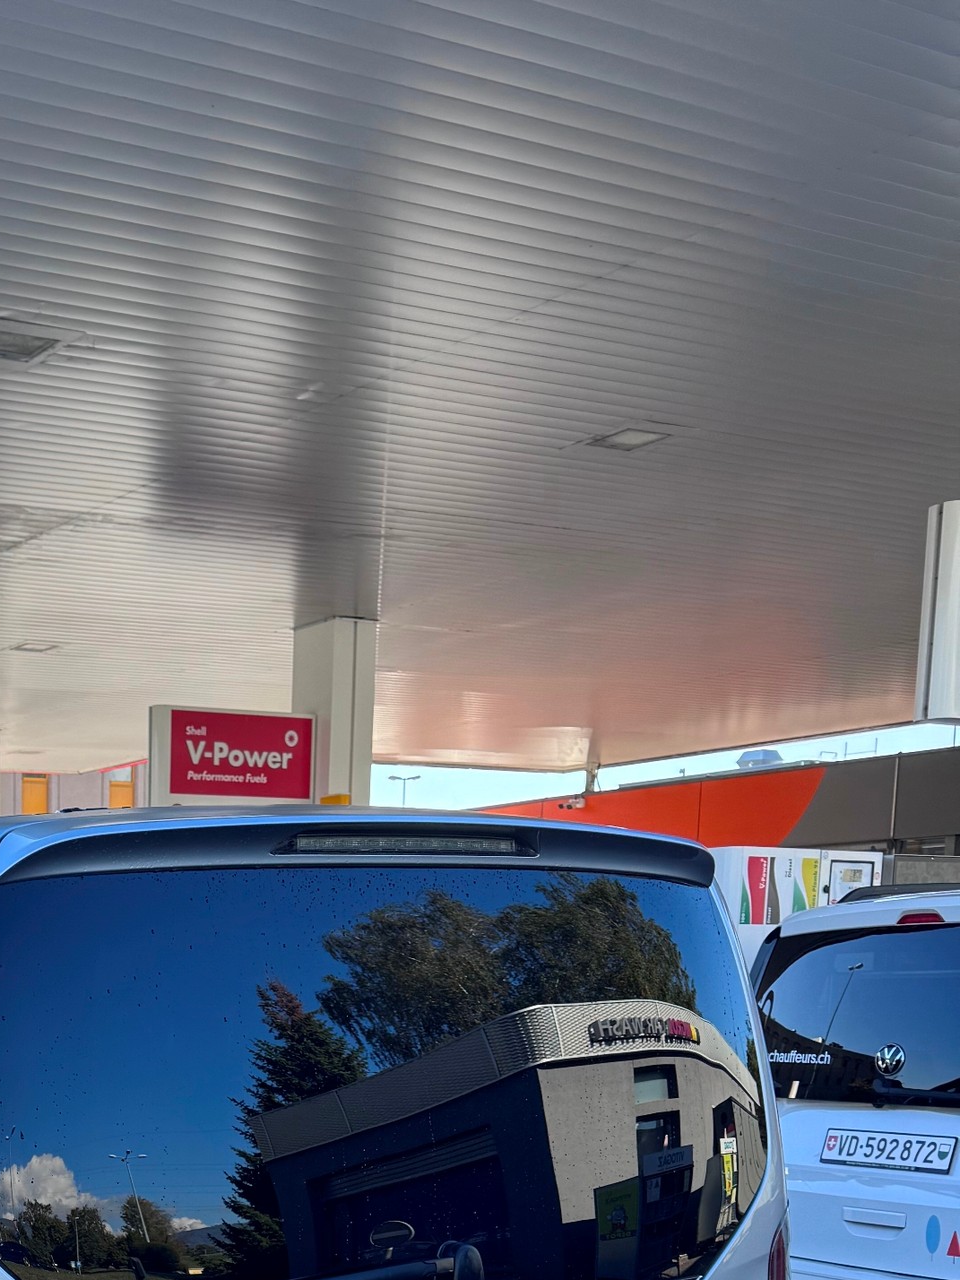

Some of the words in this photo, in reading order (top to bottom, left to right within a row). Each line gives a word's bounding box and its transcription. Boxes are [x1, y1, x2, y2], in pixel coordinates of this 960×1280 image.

[185, 726, 207, 736] Shell
[186, 740, 293, 769] V-Power
[187, 770, 244, 783] Performance
[245, 773, 268, 784] Fuels
